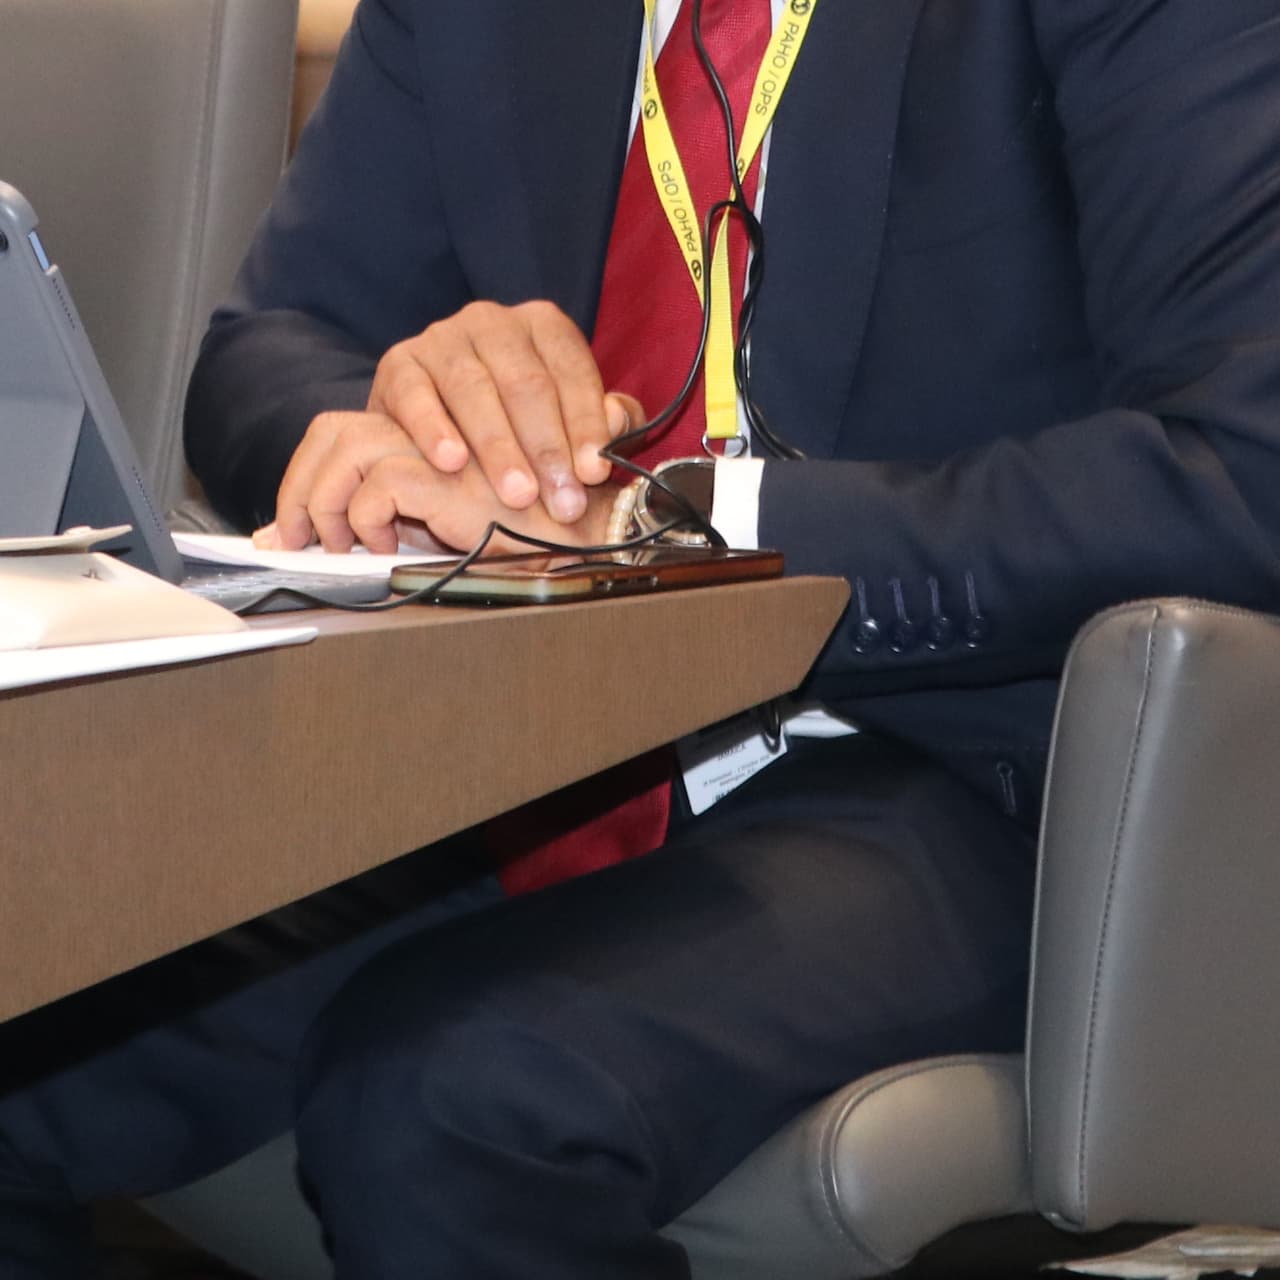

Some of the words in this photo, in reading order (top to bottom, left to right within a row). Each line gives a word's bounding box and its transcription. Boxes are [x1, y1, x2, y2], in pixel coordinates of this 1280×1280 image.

[772, 22, 800, 69] PAHO
[755, 79, 777, 117] OPS
[658, 159, 679, 197] OPS
[673, 207, 697, 252] PAHO
